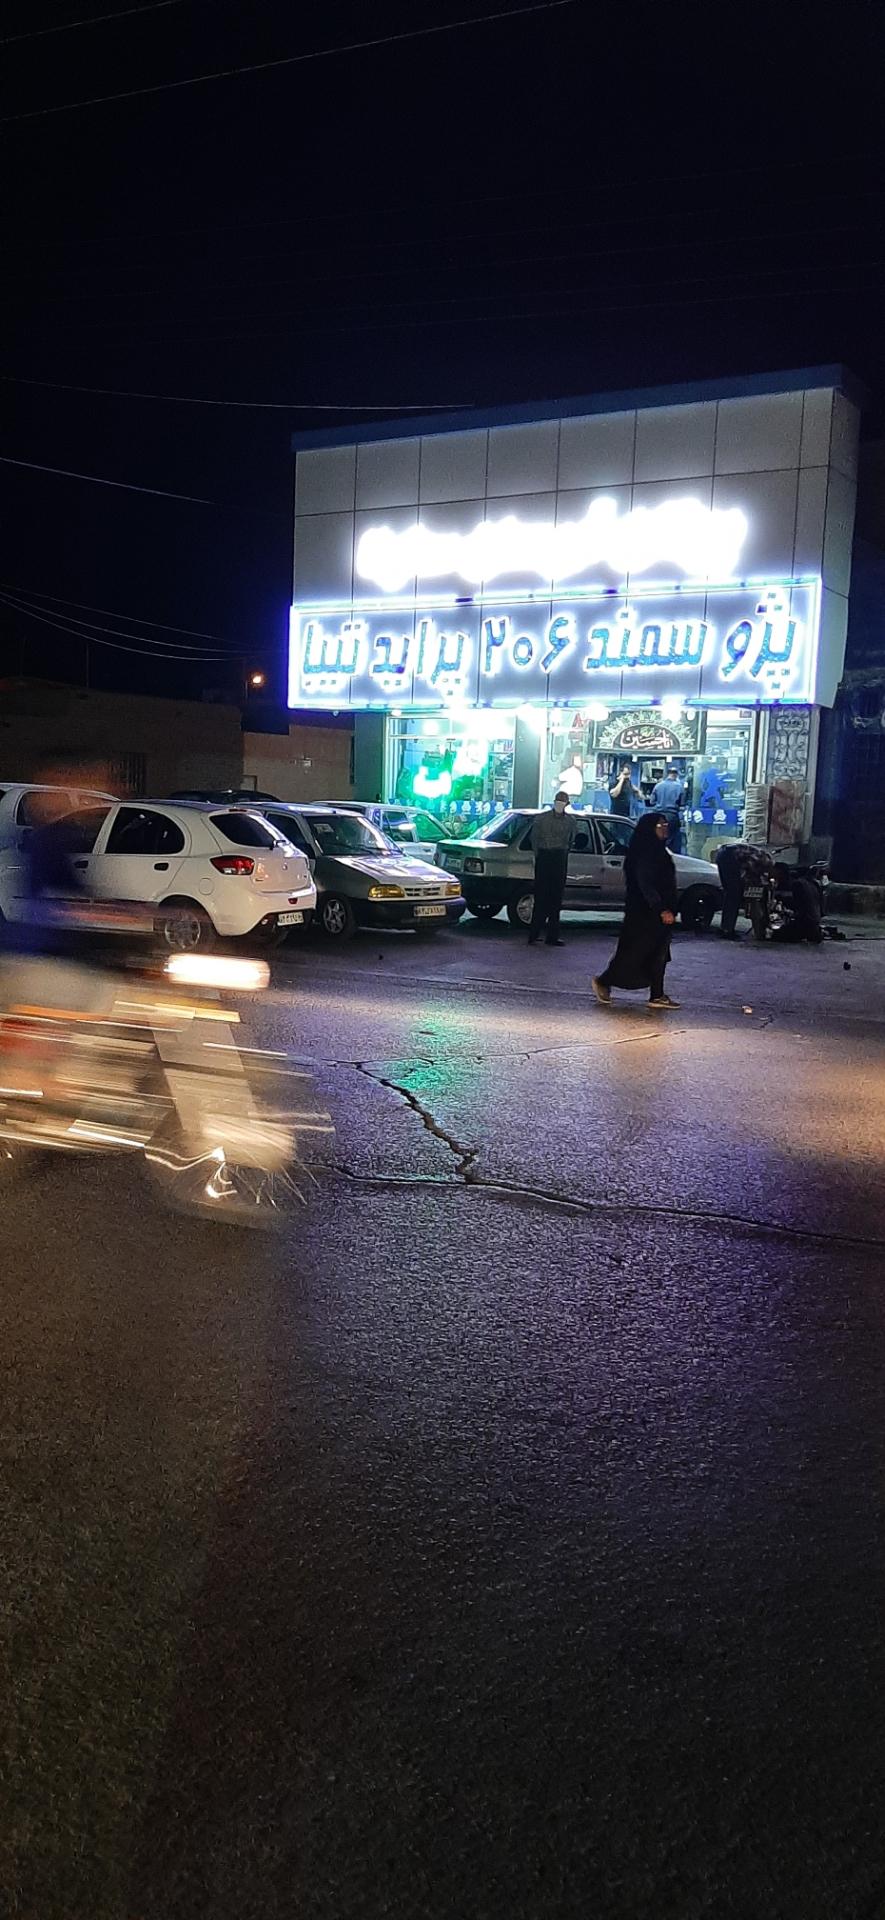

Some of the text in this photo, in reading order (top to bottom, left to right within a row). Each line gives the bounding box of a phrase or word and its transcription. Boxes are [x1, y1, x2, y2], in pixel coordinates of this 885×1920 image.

[302, 589, 798, 697] پژو سمند ۲۰۶ پراید تیبا
